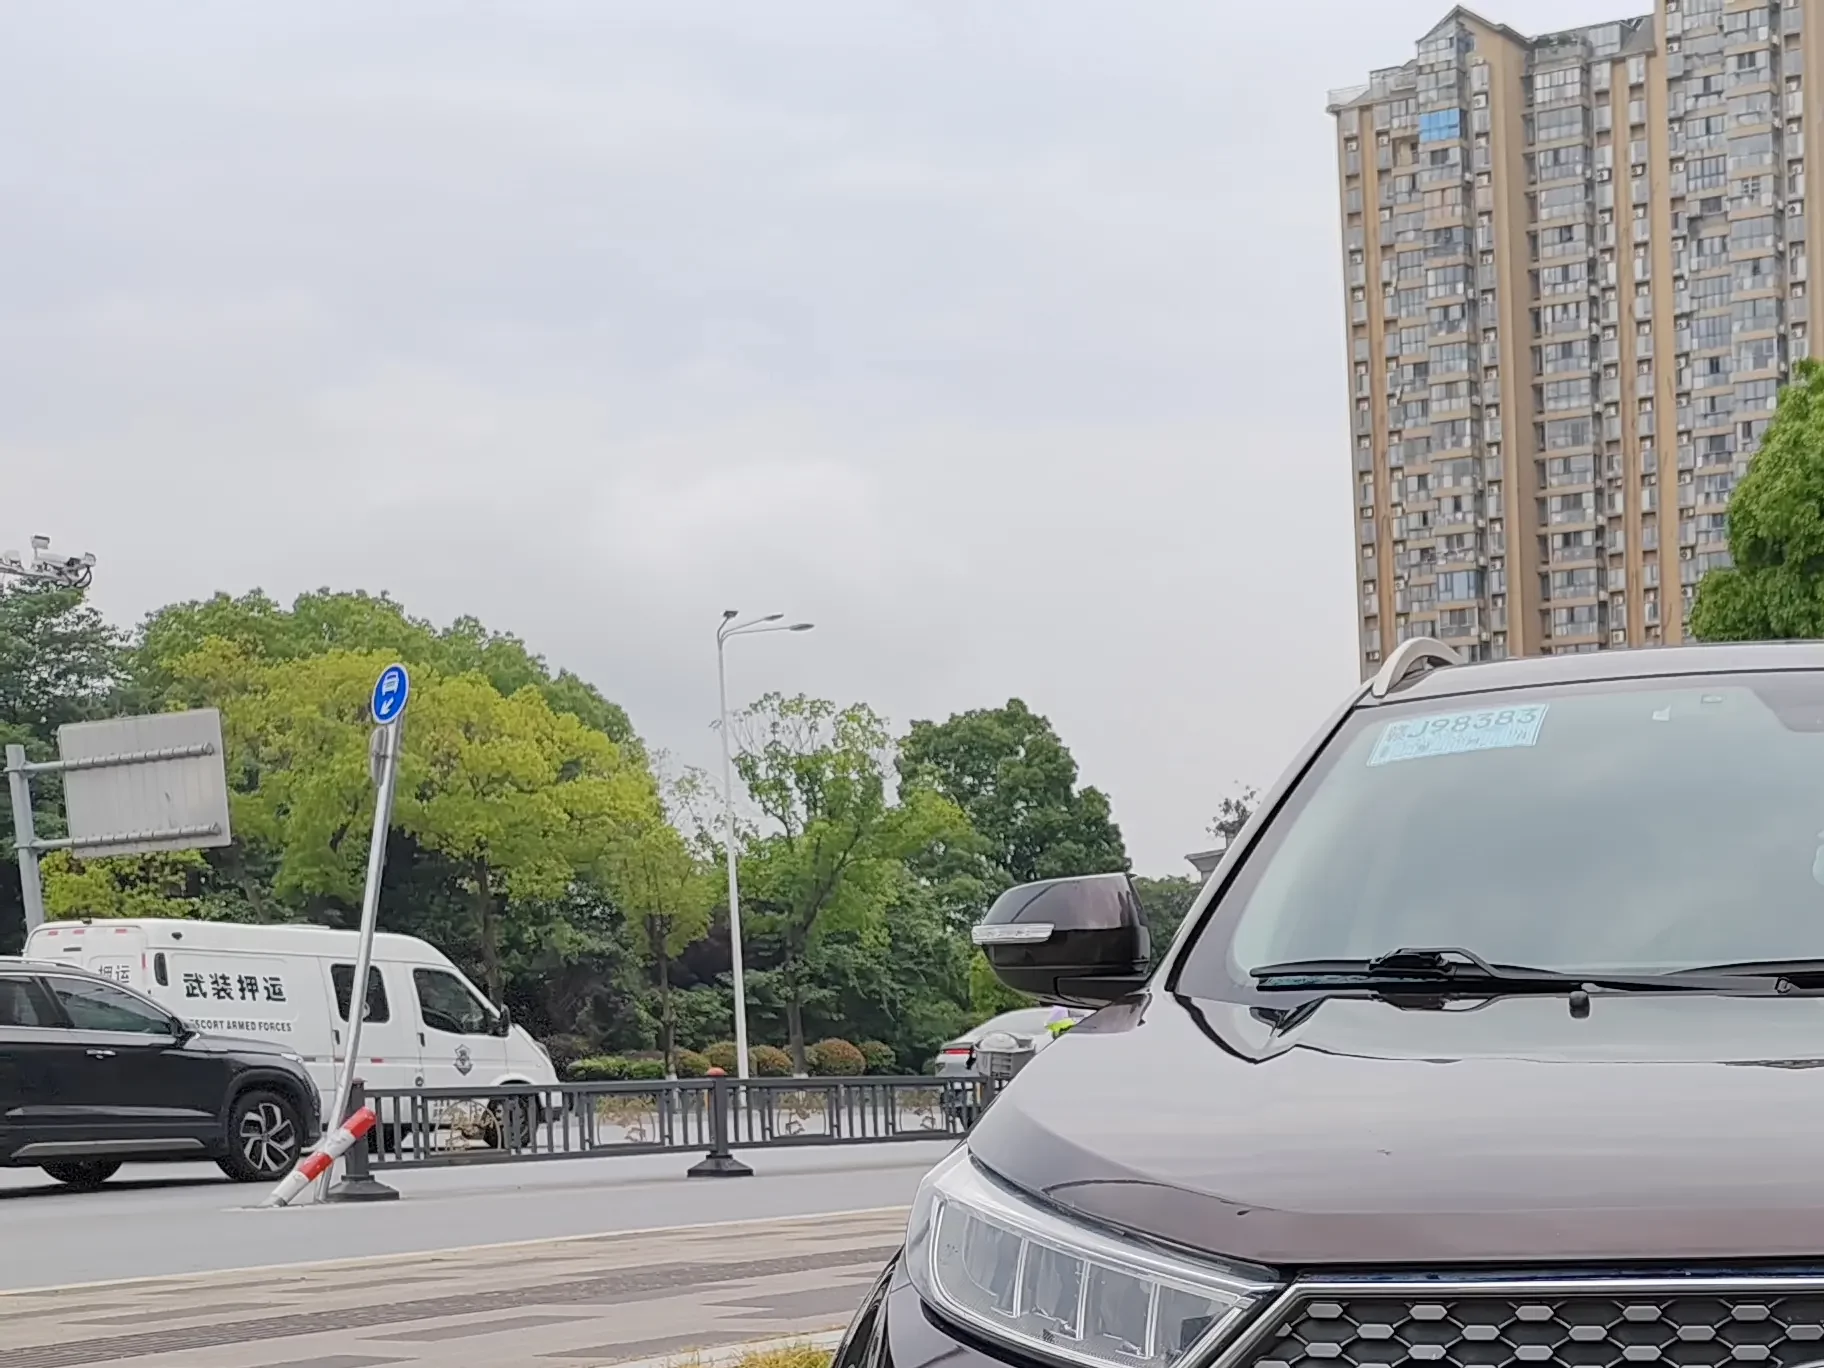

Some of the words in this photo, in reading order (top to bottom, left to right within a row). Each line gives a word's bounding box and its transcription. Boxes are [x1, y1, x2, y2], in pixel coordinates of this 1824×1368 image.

[183, 973, 287, 1002] 武装押运
[190, 1019, 224, 1030] SCORT
[226, 1020, 257, 1031] ARMED
[258, 1022, 292, 1033] FORCES
